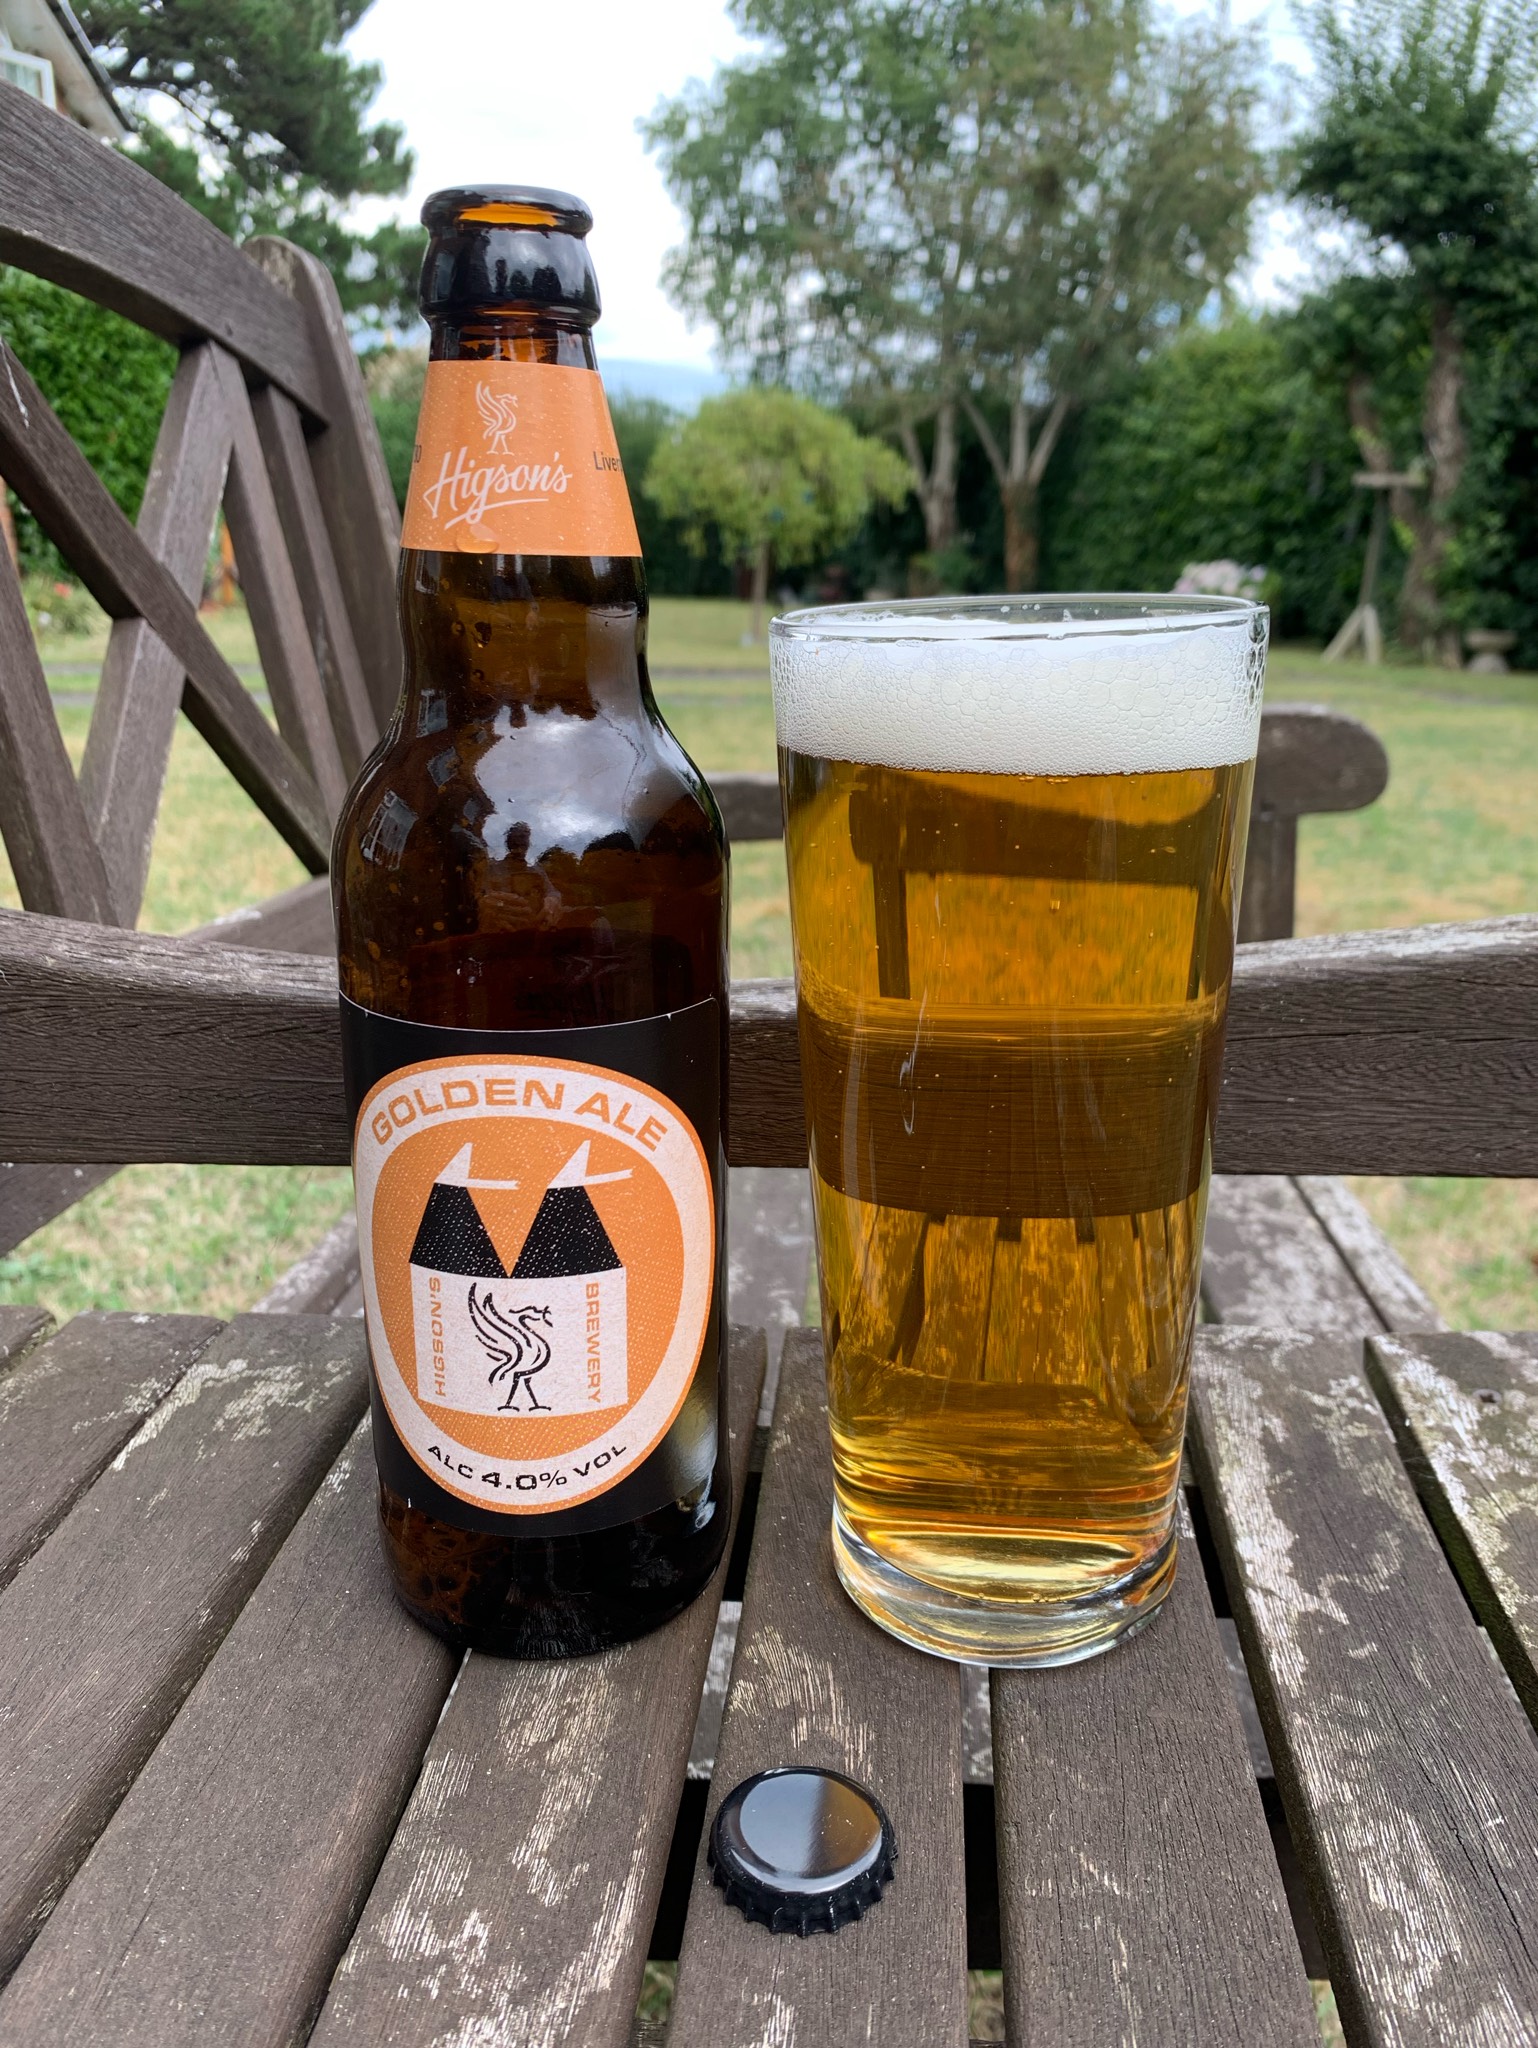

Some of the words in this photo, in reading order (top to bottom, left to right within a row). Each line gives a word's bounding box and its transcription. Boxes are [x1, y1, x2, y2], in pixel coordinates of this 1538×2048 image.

[423, 446, 573, 530] Higson's
[593, 451, 624, 475] Liver
[371, 1078, 565, 1145] GOLDEN
[574, 1091, 668, 1152] ALE
[428, 1276, 446, 1397] HIGSON'S
[585, 1282, 602, 1404] BREWERY
[427, 1445, 474, 1479] ALC
[481, 1469, 568, 1491] 4.0%
[573, 1444, 627, 1477] VOL
